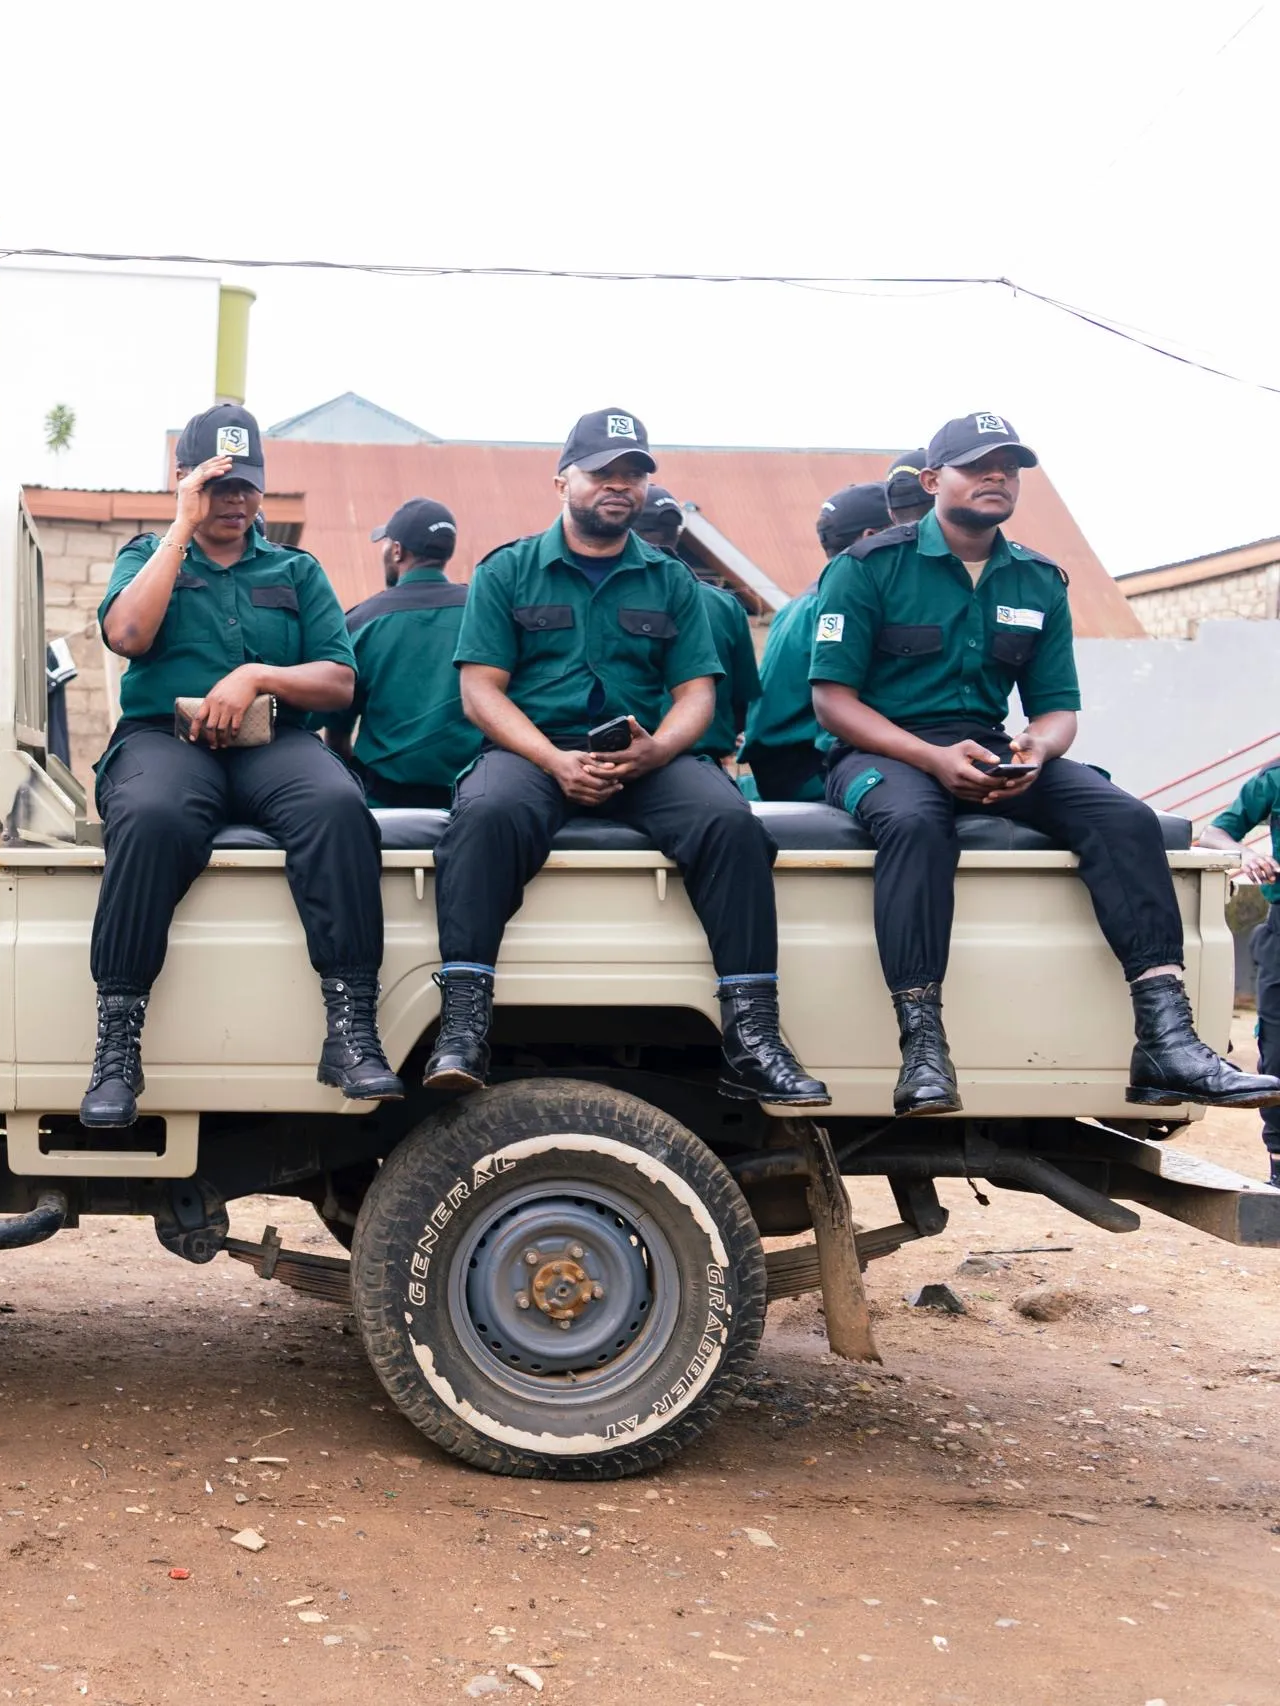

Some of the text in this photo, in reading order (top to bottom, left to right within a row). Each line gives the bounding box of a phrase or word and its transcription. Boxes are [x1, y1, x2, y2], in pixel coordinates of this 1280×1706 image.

[408, 1155, 516, 1306] GENERAL
[652, 1263, 726, 1417] GRABBER
[604, 1414, 639, 1440] AT
